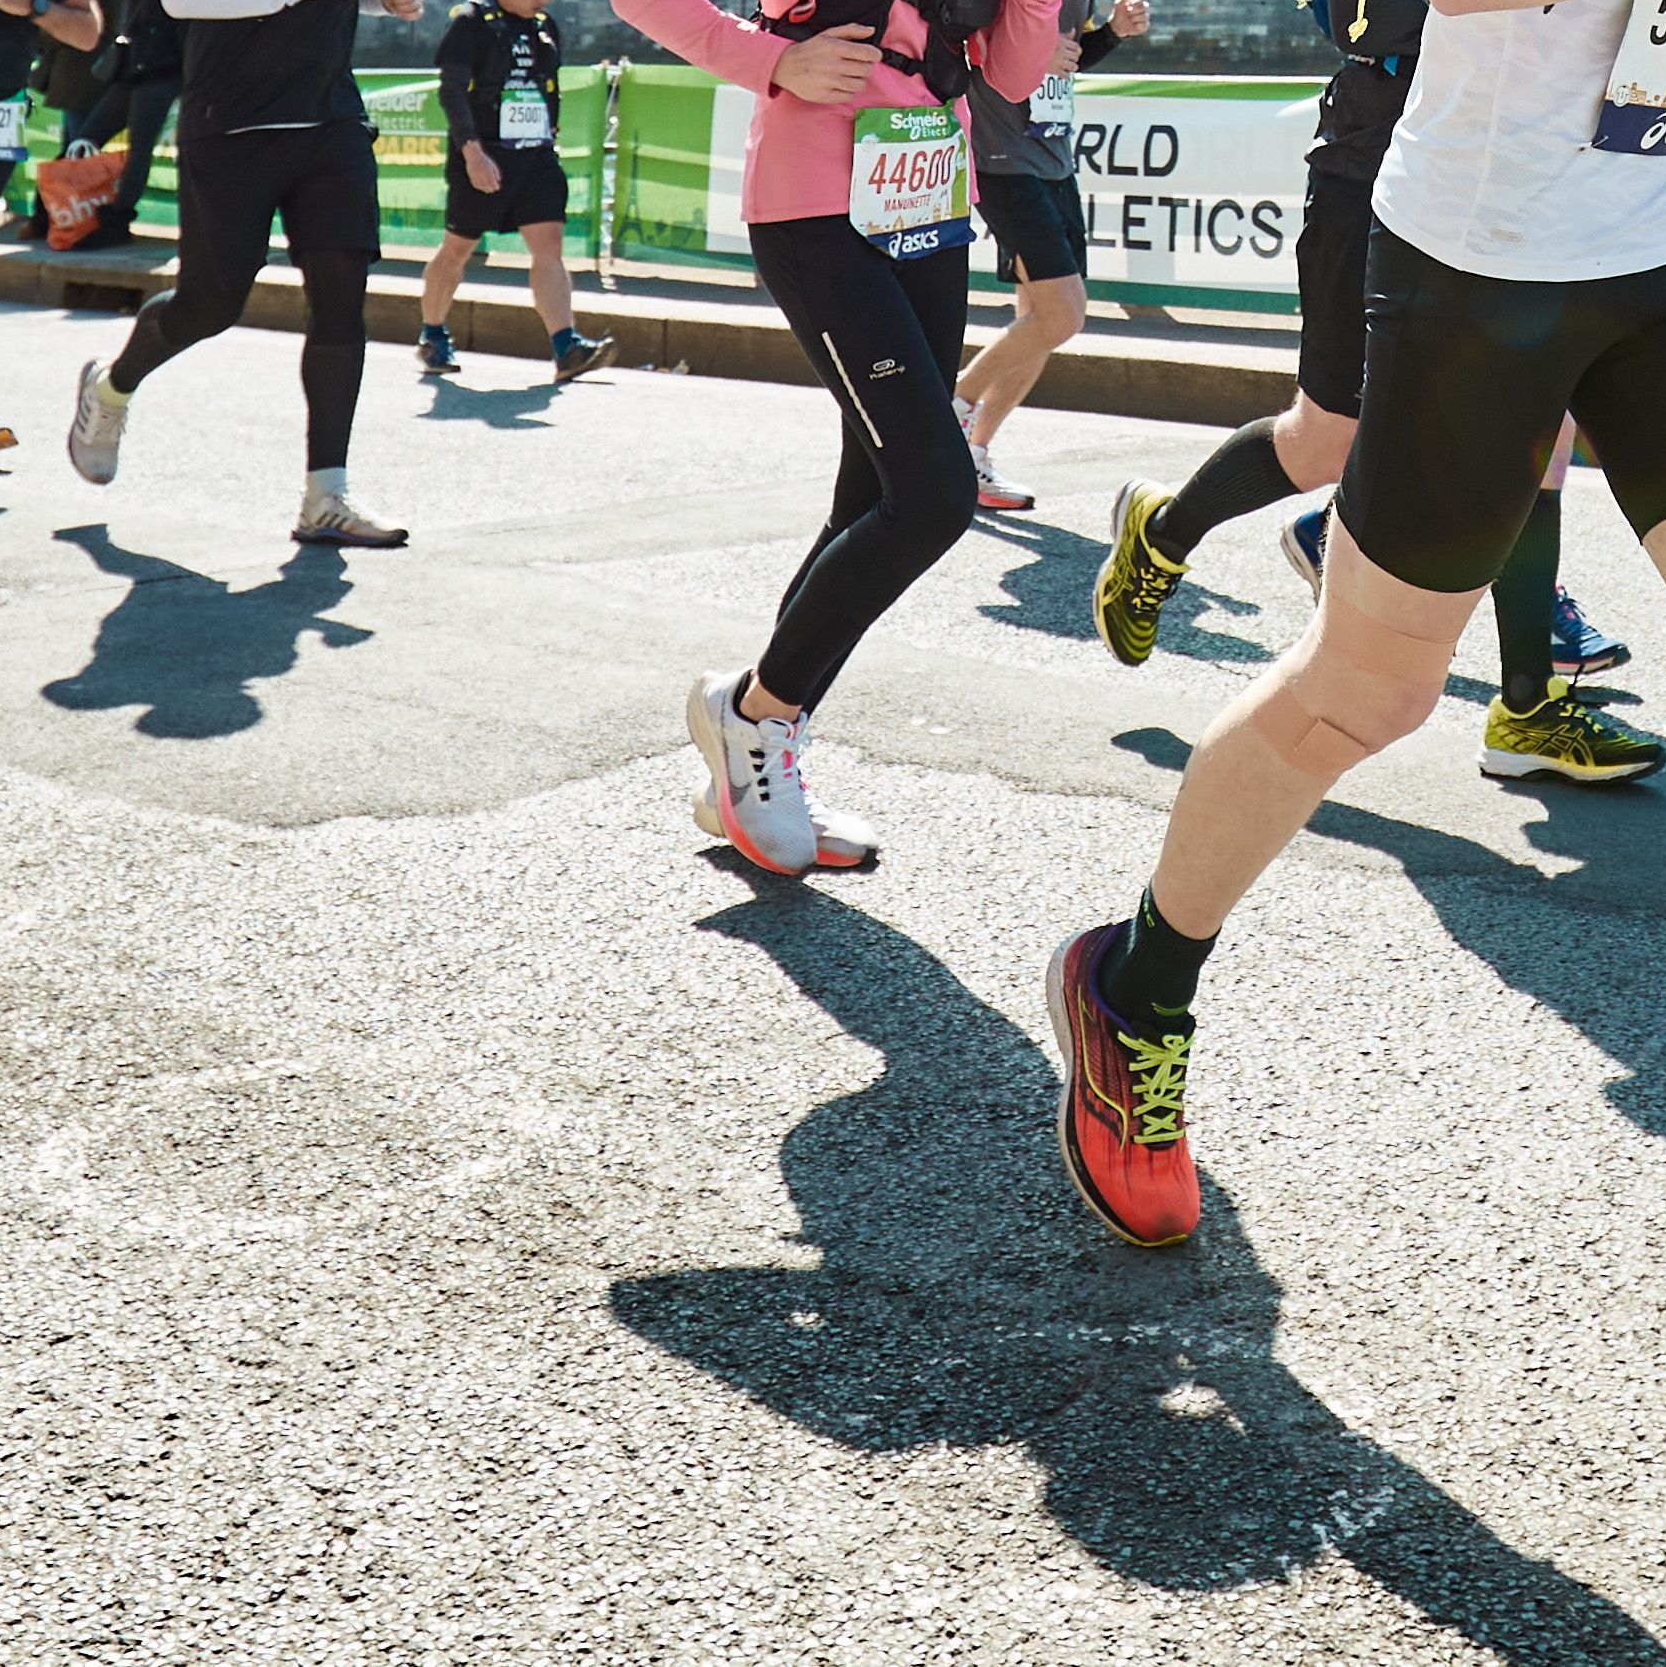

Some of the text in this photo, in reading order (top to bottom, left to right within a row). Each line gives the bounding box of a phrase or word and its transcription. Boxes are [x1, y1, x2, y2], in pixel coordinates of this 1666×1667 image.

[869, 145, 955, 194] 44600
[1076, 124, 1179, 177] RLD
[902, 230, 939, 253] asics
[1087, 194, 1283, 259] LETICS
